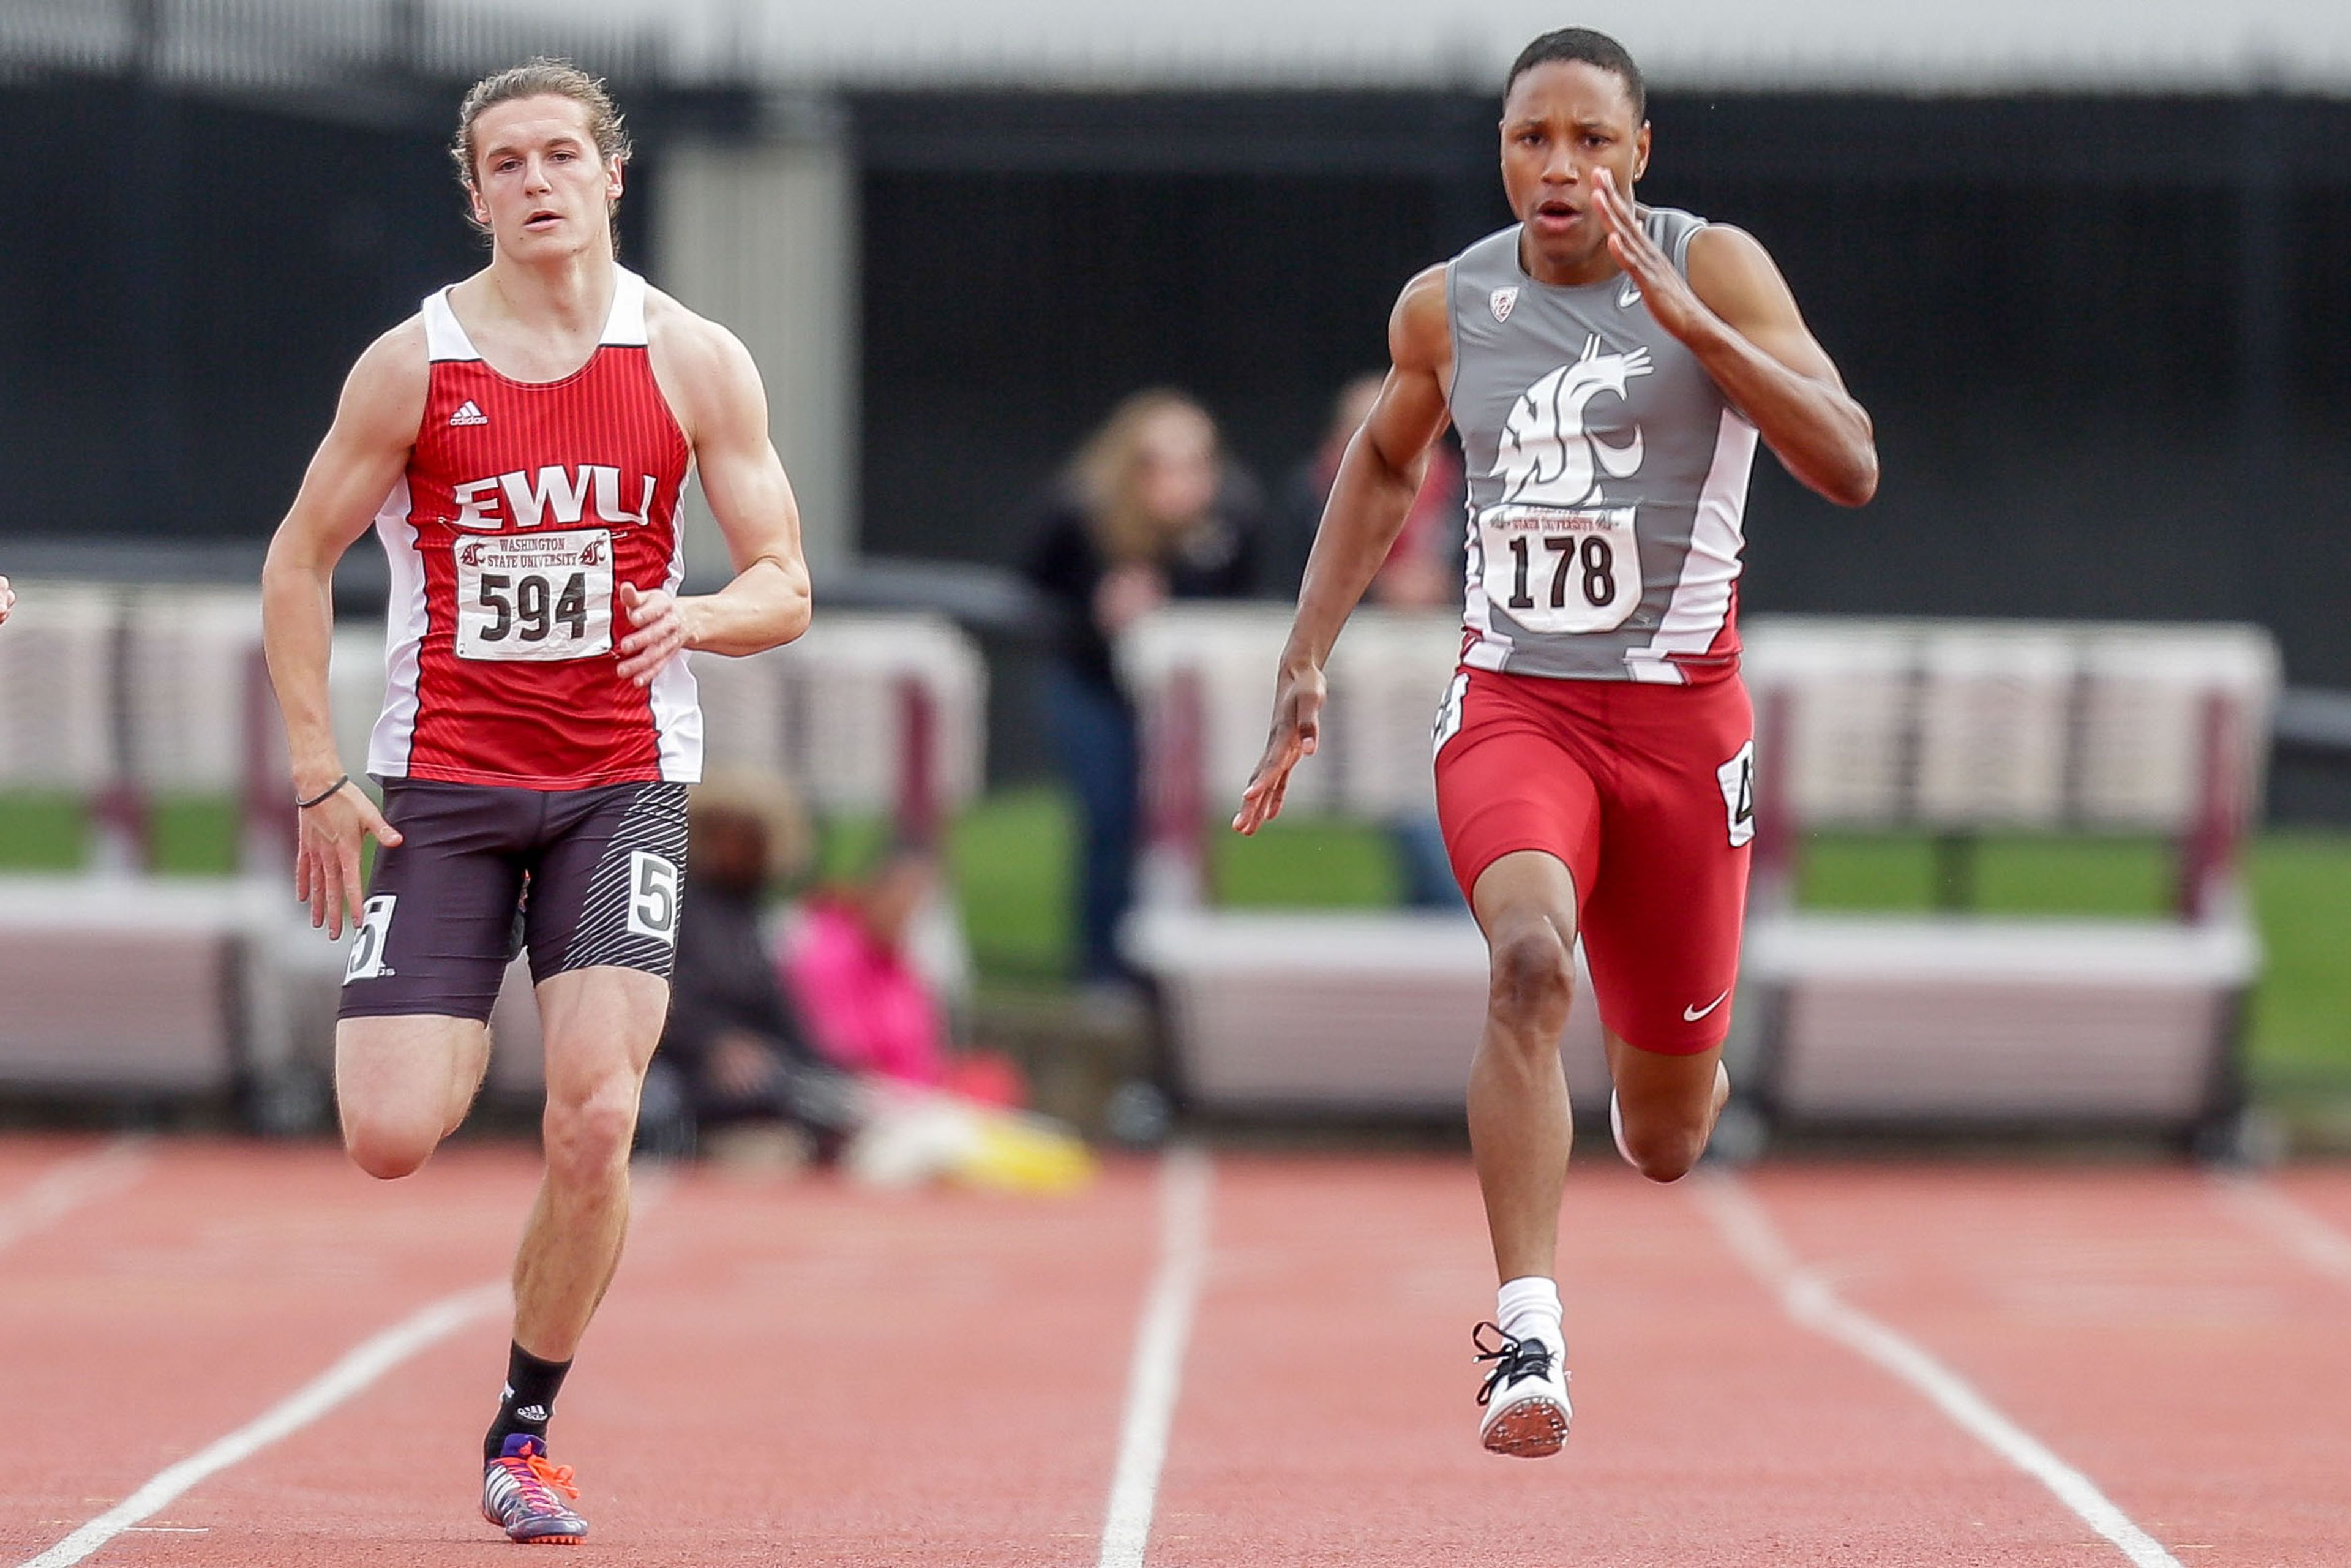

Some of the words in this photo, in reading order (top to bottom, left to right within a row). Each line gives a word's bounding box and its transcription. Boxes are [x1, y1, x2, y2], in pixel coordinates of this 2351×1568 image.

[450, 416, 488, 426] adidas
[452, 464, 657, 529] EWU
[488, 555, 518, 568] STATE
[520, 553, 577, 568] UNIVERSITY
[500, 538, 565, 551] WASHINGTON
[1509, 536, 1616, 609] 178
[479, 573, 587, 642] 594
[637, 858, 673, 932] 5
